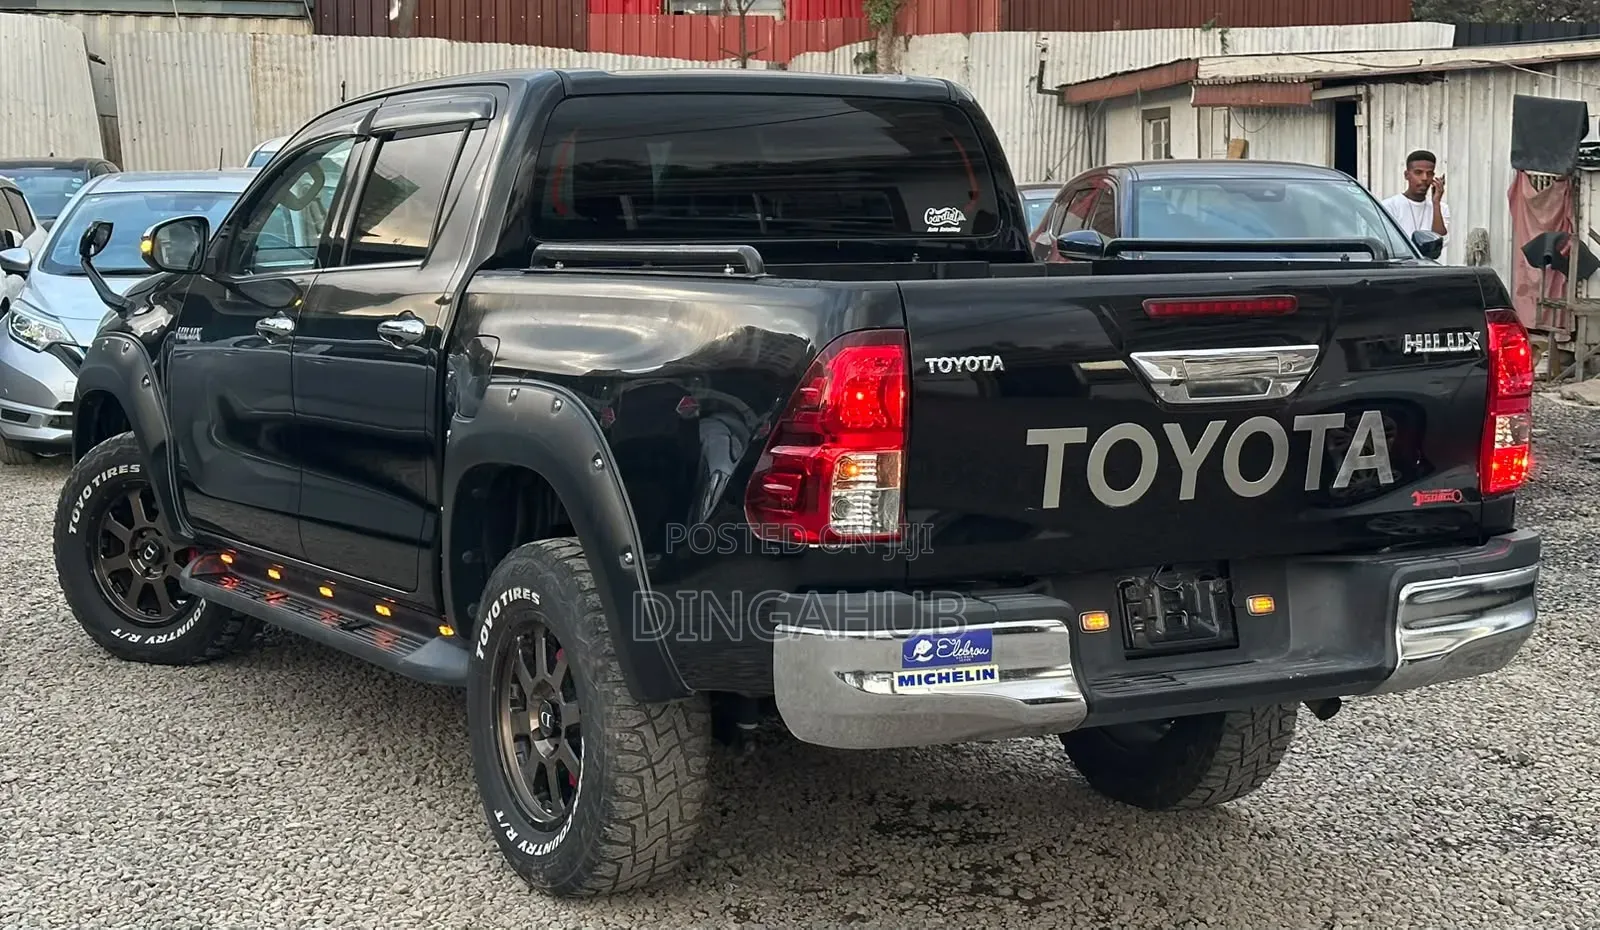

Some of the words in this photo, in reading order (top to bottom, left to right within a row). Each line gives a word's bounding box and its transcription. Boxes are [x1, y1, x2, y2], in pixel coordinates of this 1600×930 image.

[1403, 331, 1481, 354] HILUX
[924, 355, 1005, 374] TOYOTA
[1026, 410, 1394, 508] TOYOTA
[69, 485, 93, 534] TOYO
[91, 464, 141, 487] TIRES
[110, 628, 142, 643] R/T
[144, 598, 207, 645] COUNTRY
[476, 600, 501, 660] TOYO
[500, 587, 540, 606] TIRES
[897, 668, 995, 687] MICHELIN
[494, 809, 519, 842] R/T
[517, 813, 573, 855] COUNTRY
